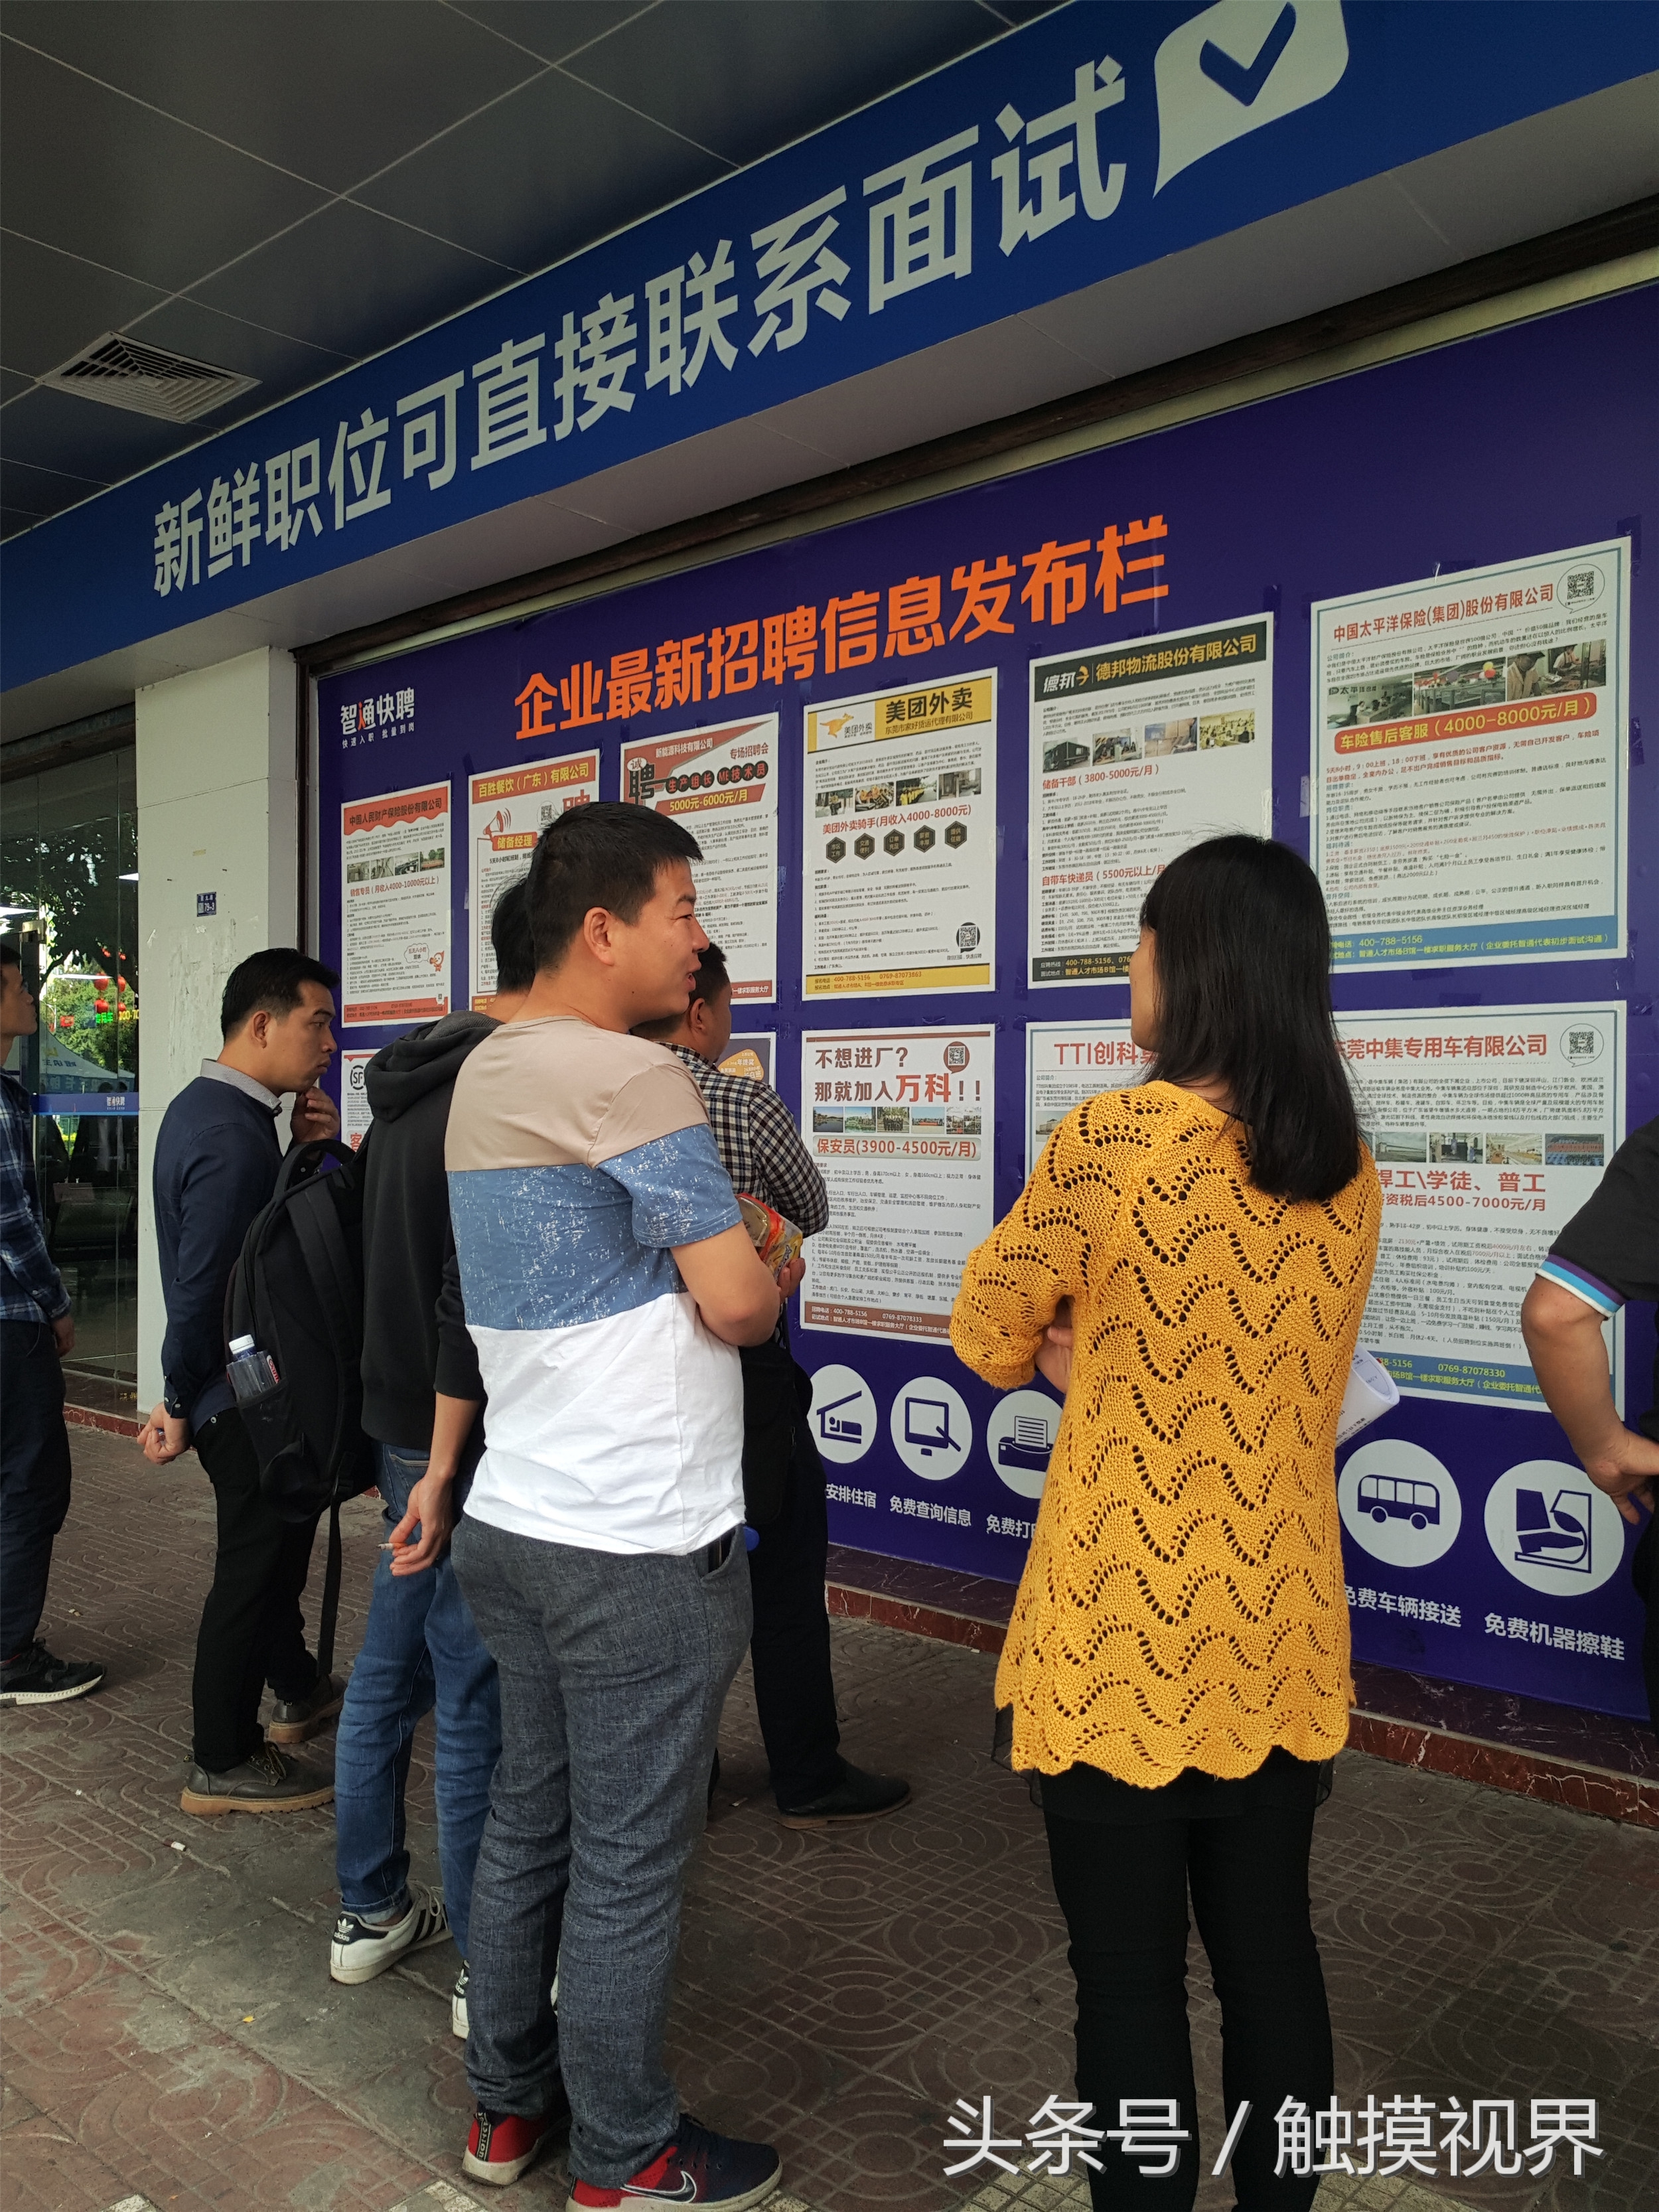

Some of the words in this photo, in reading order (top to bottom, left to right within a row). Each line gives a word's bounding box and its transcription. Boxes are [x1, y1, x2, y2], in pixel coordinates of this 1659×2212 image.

[153, 56, 1126, 597] 新鲜职位可直接联系面试
[1333, 583, 1554, 642] 中国太平洋保险(集团)股份有限公司
[514, 515, 1168, 739] 企业最新招聘信息发布栏
[1095, 633, 1257, 682] 德邦物流股份有限公司
[340, 687, 415, 735] 智通快聘
[886, 687, 972, 724] 美团外卖
[342, 733, 374, 749] 快速入职
[382, 721, 415, 739] 批量到岗
[844, 722, 873, 735] 美团外卖
[656, 738, 713, 759] 新能源科技有限公司
[730, 742, 769, 760] 专场招聘会
[630, 759, 642, 770] 诚
[478, 762, 589, 798] 百胜餐饮（广东）有限公司
[668, 773, 712, 792] 生产组长
[349, 798, 442, 826] 中国人民财产保险股份有限公司
[670, 790, 747, 812] 5000元-6000元/月
[823, 804, 972, 834] 美团外卖骑手(月收入4000-8000元)
[498, 834, 532, 849] 储备经理
[1358, 934, 1423, 947] 400-788-5156
[815, 1047, 908, 1069] 不想进厂？
[817, 1138, 977, 1158] 保安员(3900-4500元/月)
[1382, 1192, 1546, 1212] 资税后4500-7000元/月
[1437, 1363, 1506, 1378] 0769-87078330
[826, 1483, 877, 1510] 安排住宿
[890, 1495, 972, 1527] 免费查询信息
[1342, 1584, 1462, 1628] 免费车辆接送
[1484, 1612, 1625, 1661] 免费机器擦鞋
[334, 1932, 350, 1943] adidas
